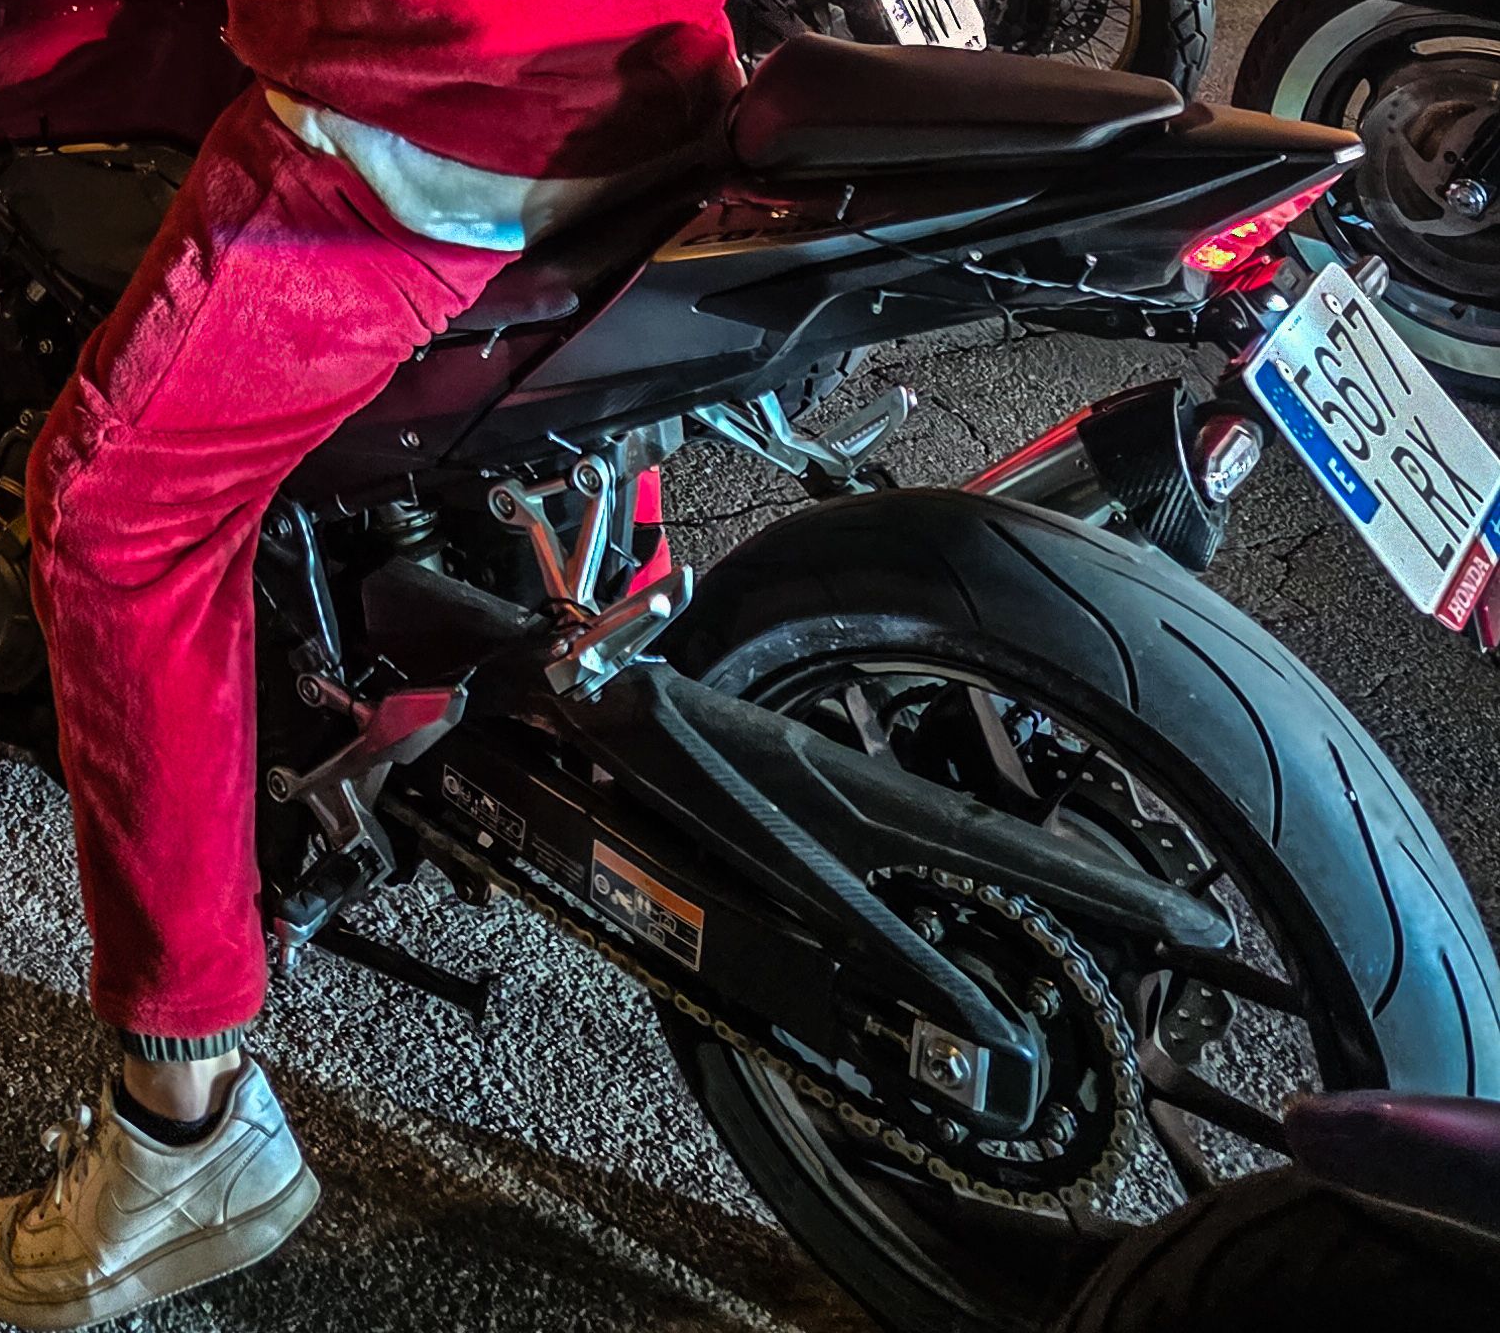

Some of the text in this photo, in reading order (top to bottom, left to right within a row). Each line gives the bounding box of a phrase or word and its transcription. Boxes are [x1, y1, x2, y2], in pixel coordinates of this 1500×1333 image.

[1293, 297, 1412, 462] 5677
[1326, 456, 1358, 495] E
[1373, 415, 1485, 573] LRX
[1446, 555, 1491, 624] HONDA
